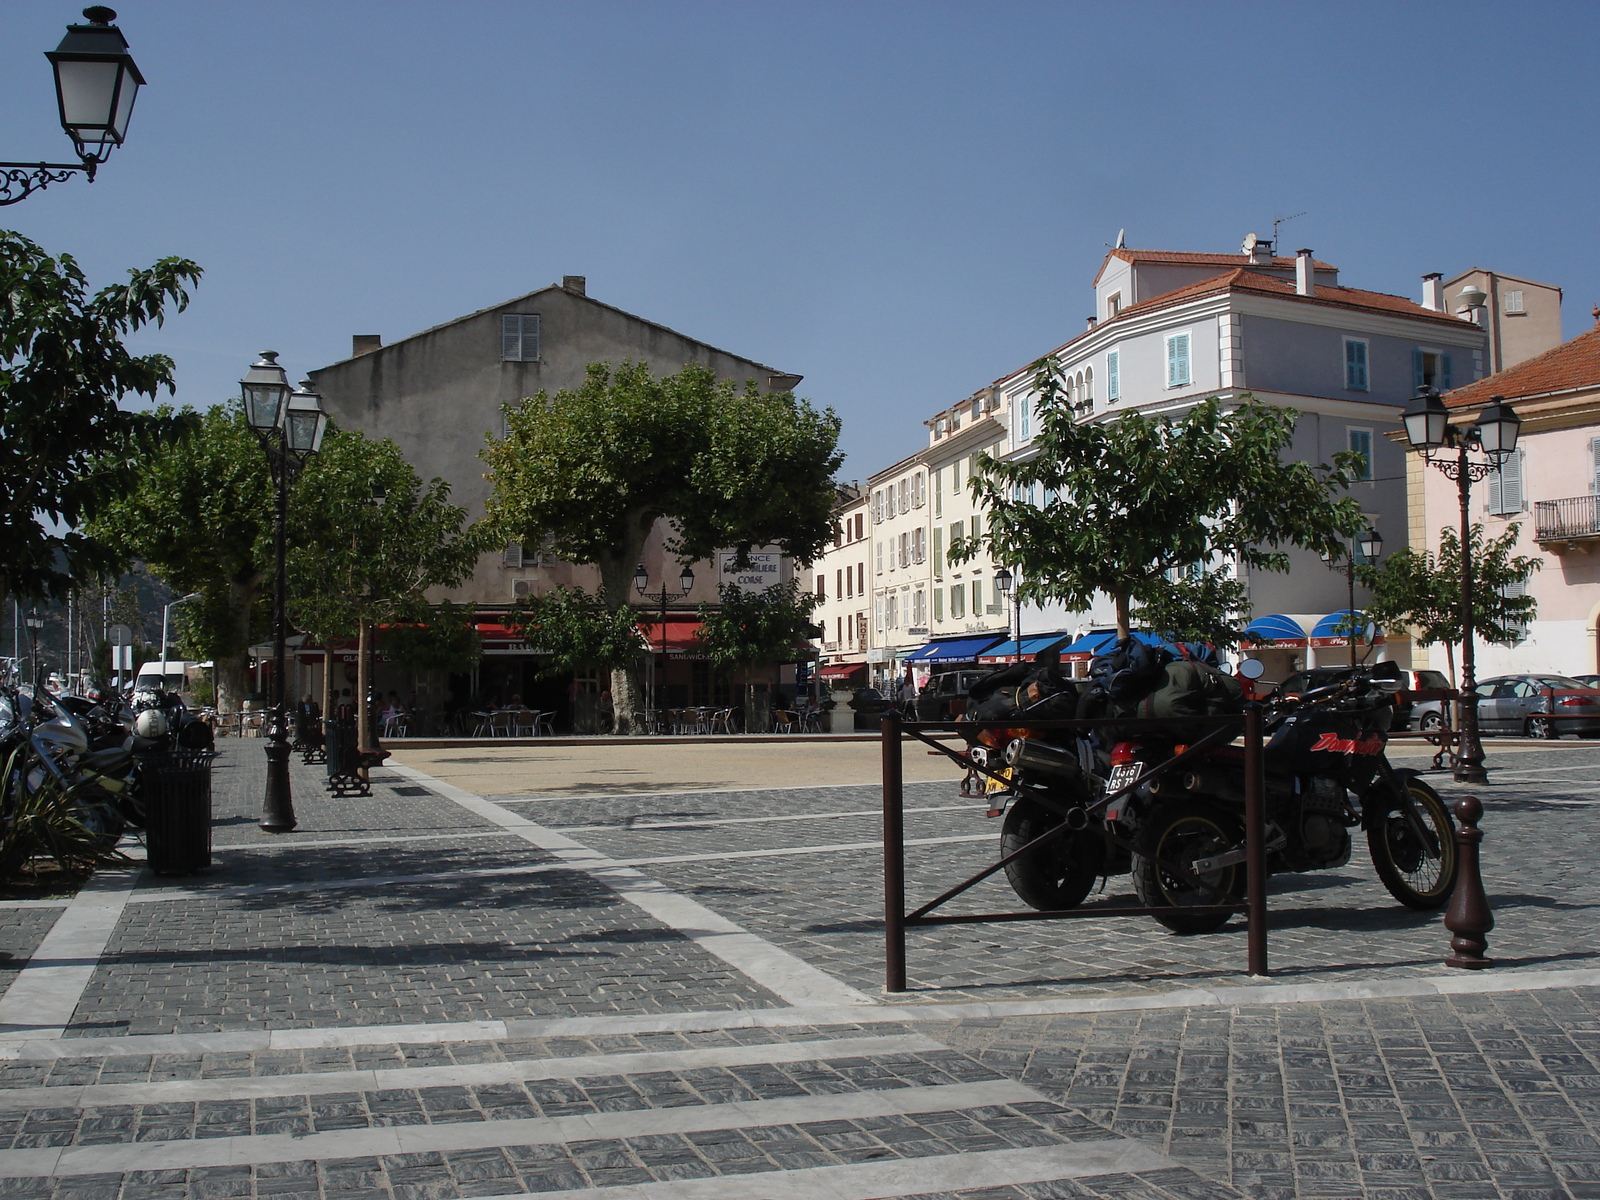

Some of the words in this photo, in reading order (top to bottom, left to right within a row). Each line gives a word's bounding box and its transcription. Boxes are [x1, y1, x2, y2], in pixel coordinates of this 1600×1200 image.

[737, 575, 763, 584] CORSE
[669, 653, 716, 661] SANDWICHE
[1110, 779, 1122, 789] RS
